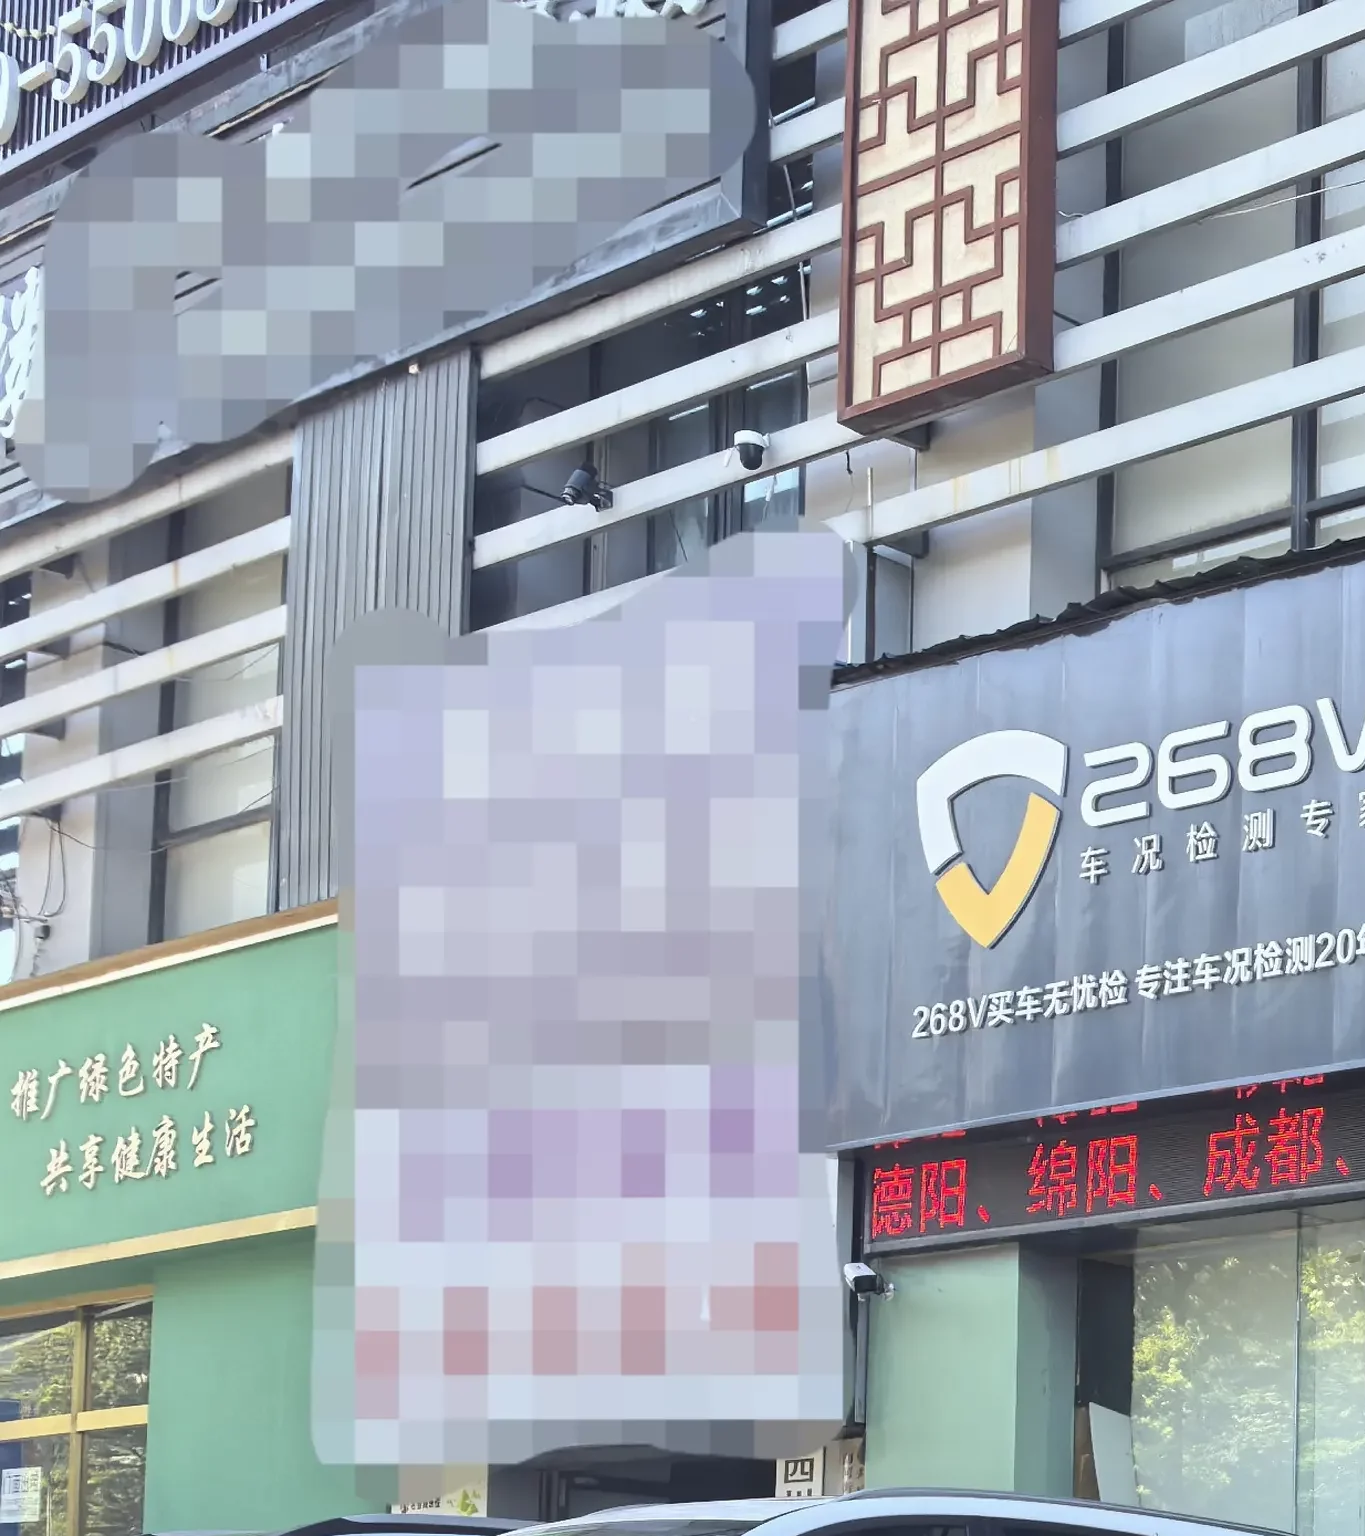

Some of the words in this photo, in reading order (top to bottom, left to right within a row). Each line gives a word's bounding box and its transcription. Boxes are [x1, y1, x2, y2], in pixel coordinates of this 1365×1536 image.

[911, 970, 1129, 1039] 268V买车无忧检
[10, 1022, 222, 1121] 推广绿色特产
[40, 1104, 256, 1197] 共享健康生活
